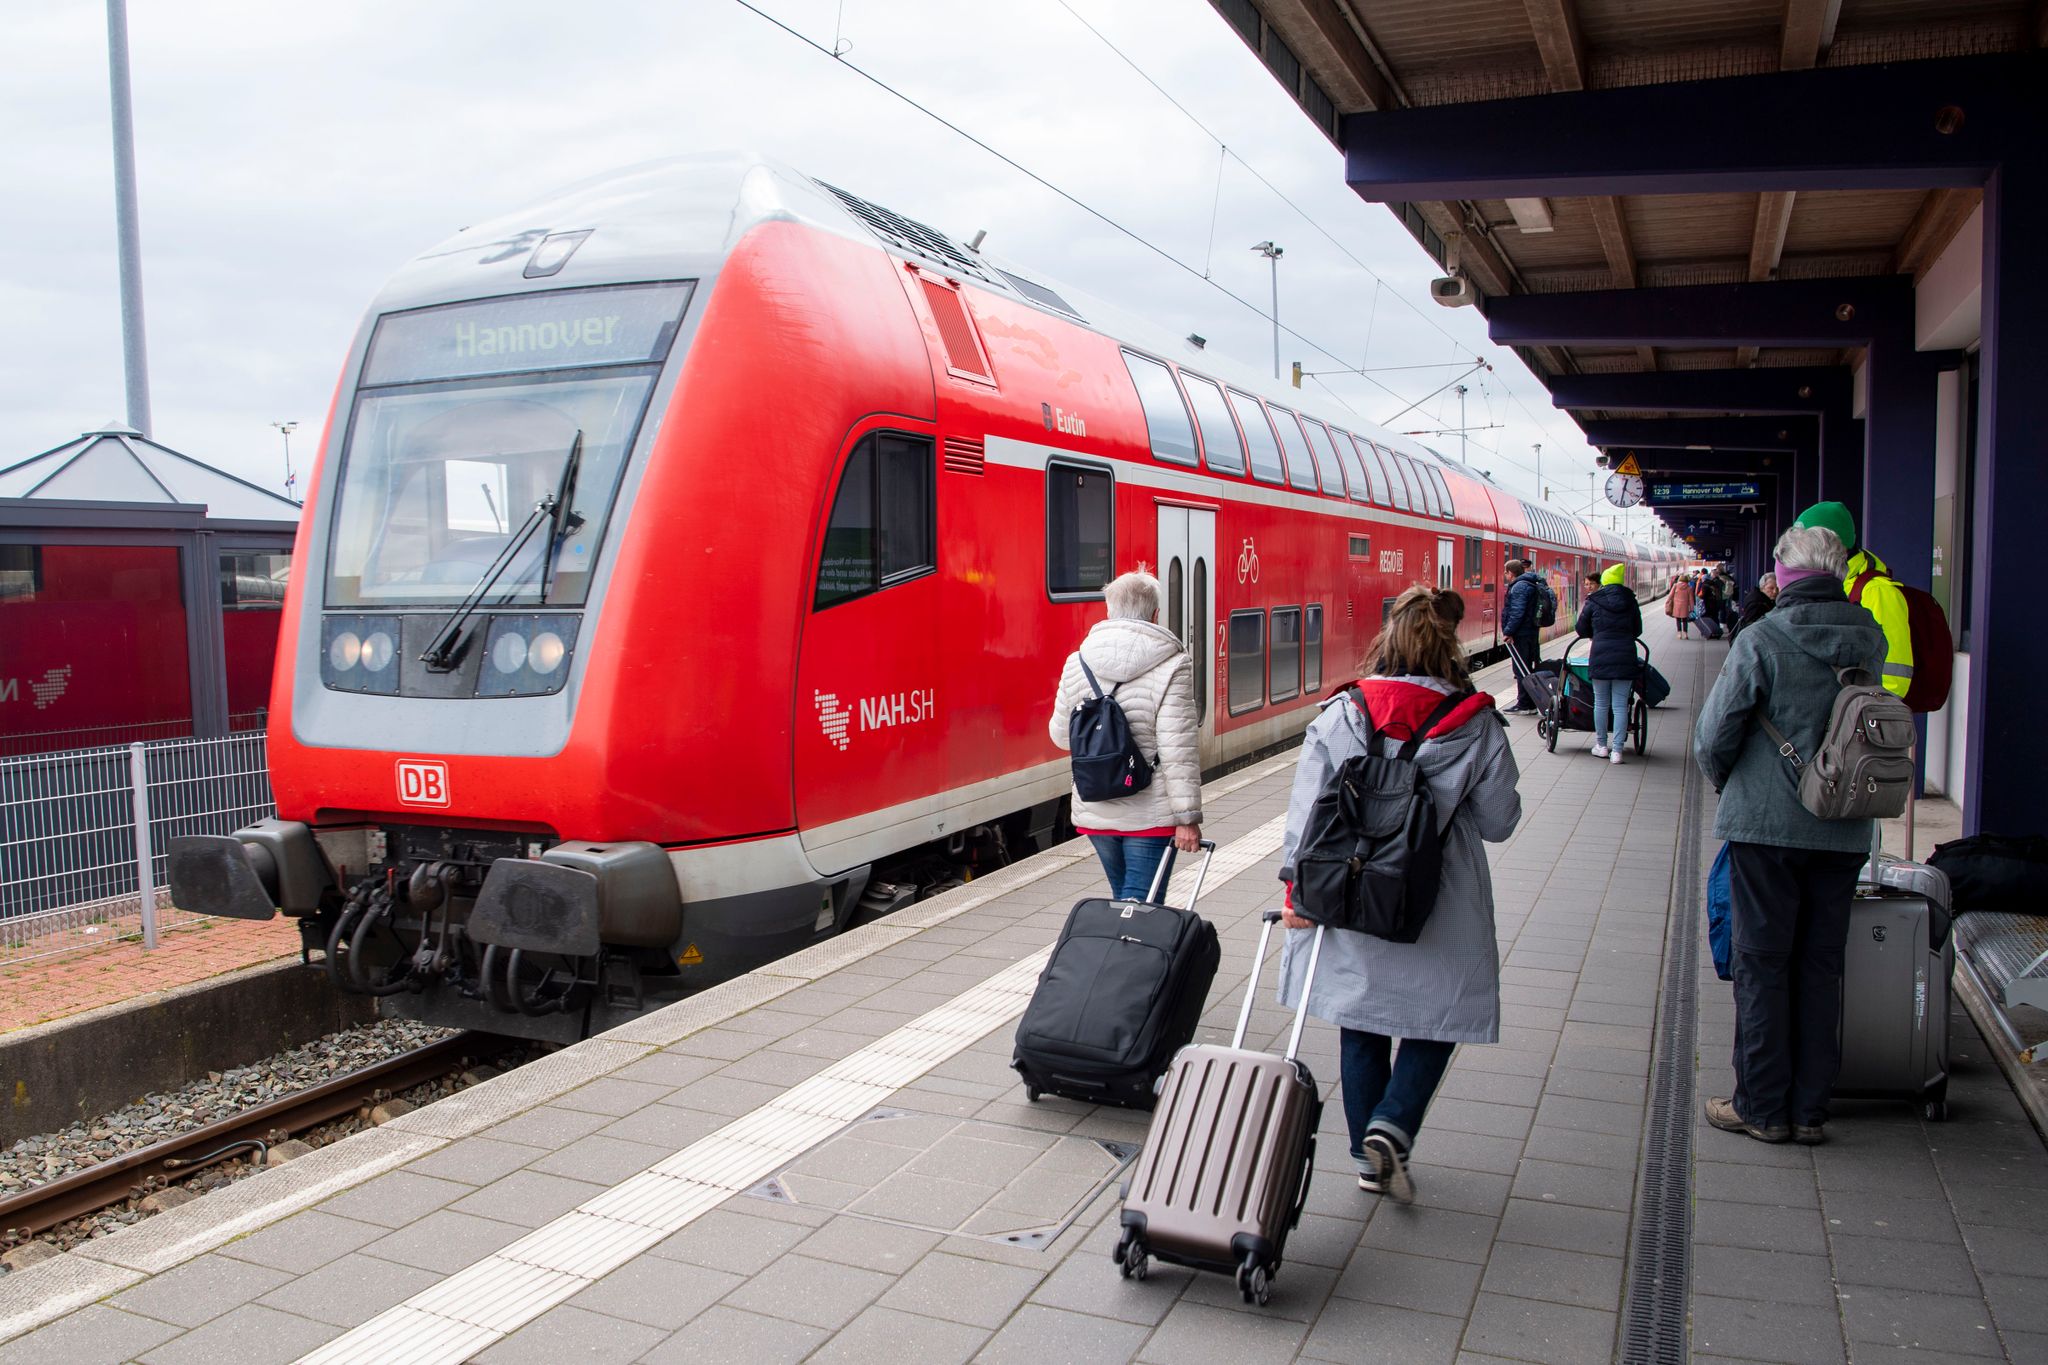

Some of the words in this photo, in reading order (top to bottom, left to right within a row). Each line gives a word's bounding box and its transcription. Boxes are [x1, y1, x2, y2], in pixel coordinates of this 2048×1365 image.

[454, 313, 621, 358] Hannover
[1055, 407, 1087, 438] Eutin
[1379, 550, 1397, 573] REGIO
[1218, 623, 1226, 657] 2
[860, 688, 934, 732] NAH.SH
[403, 767, 442, 799] DB
